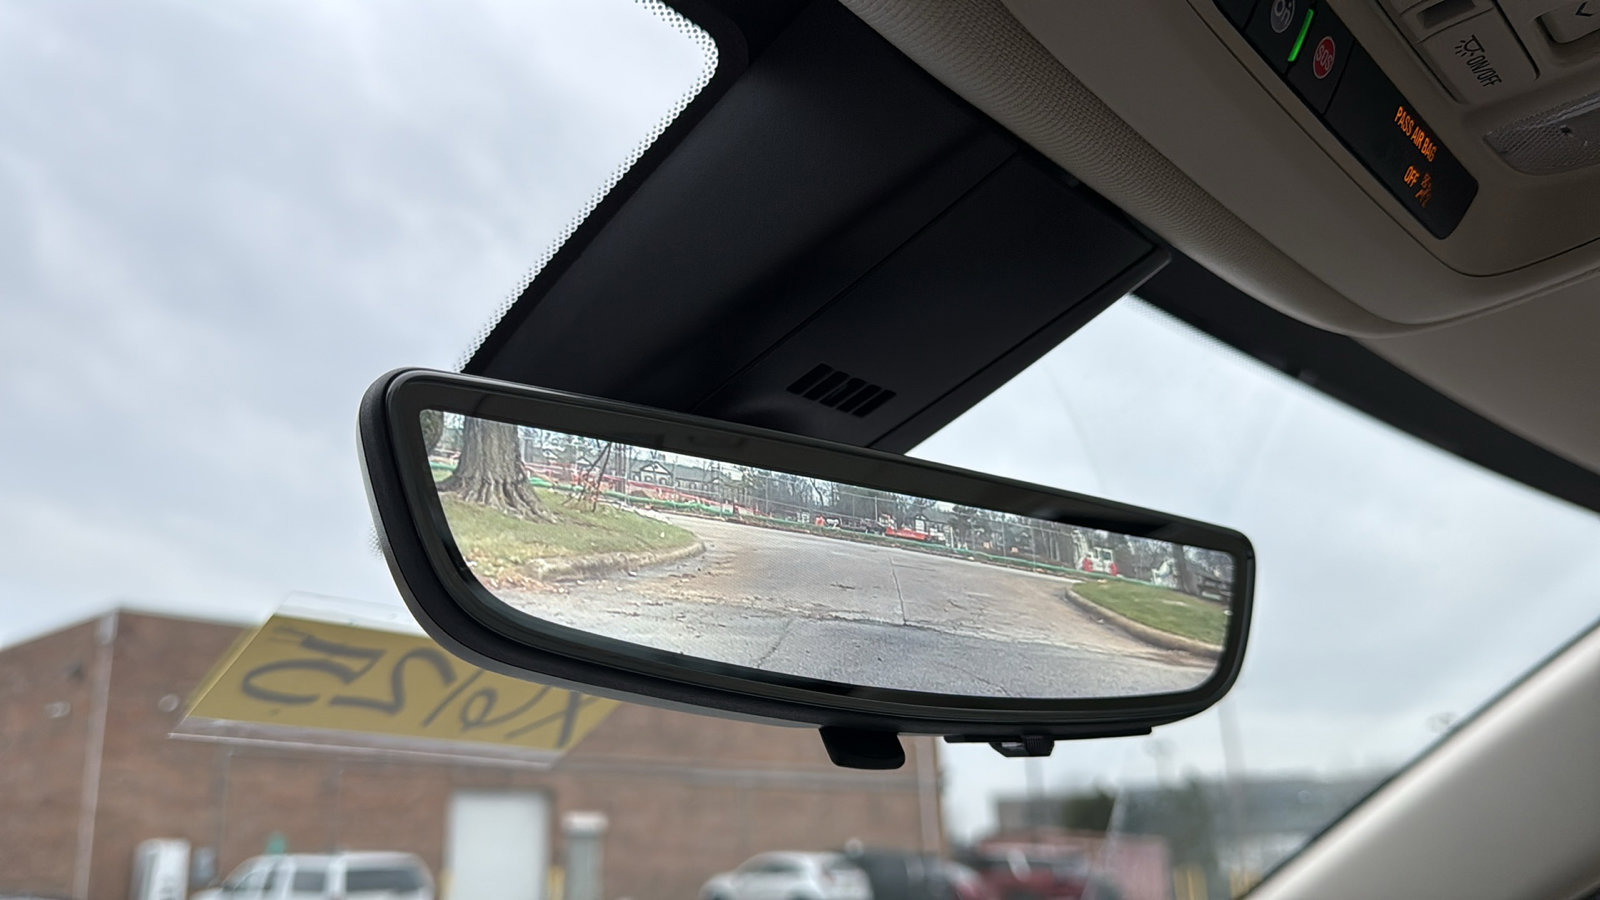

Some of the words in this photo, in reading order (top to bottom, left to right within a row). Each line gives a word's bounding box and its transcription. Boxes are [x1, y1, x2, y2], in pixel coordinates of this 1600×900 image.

[1316, 44, 1333, 71] SOS
[1466, 55, 1502, 87] ON/OFF
[1394, 105, 1414, 137] PASS
[1410, 126, 1425, 150] AIR
[1421, 137, 1437, 162] BAG
[1403, 165, 1420, 188] OFF
